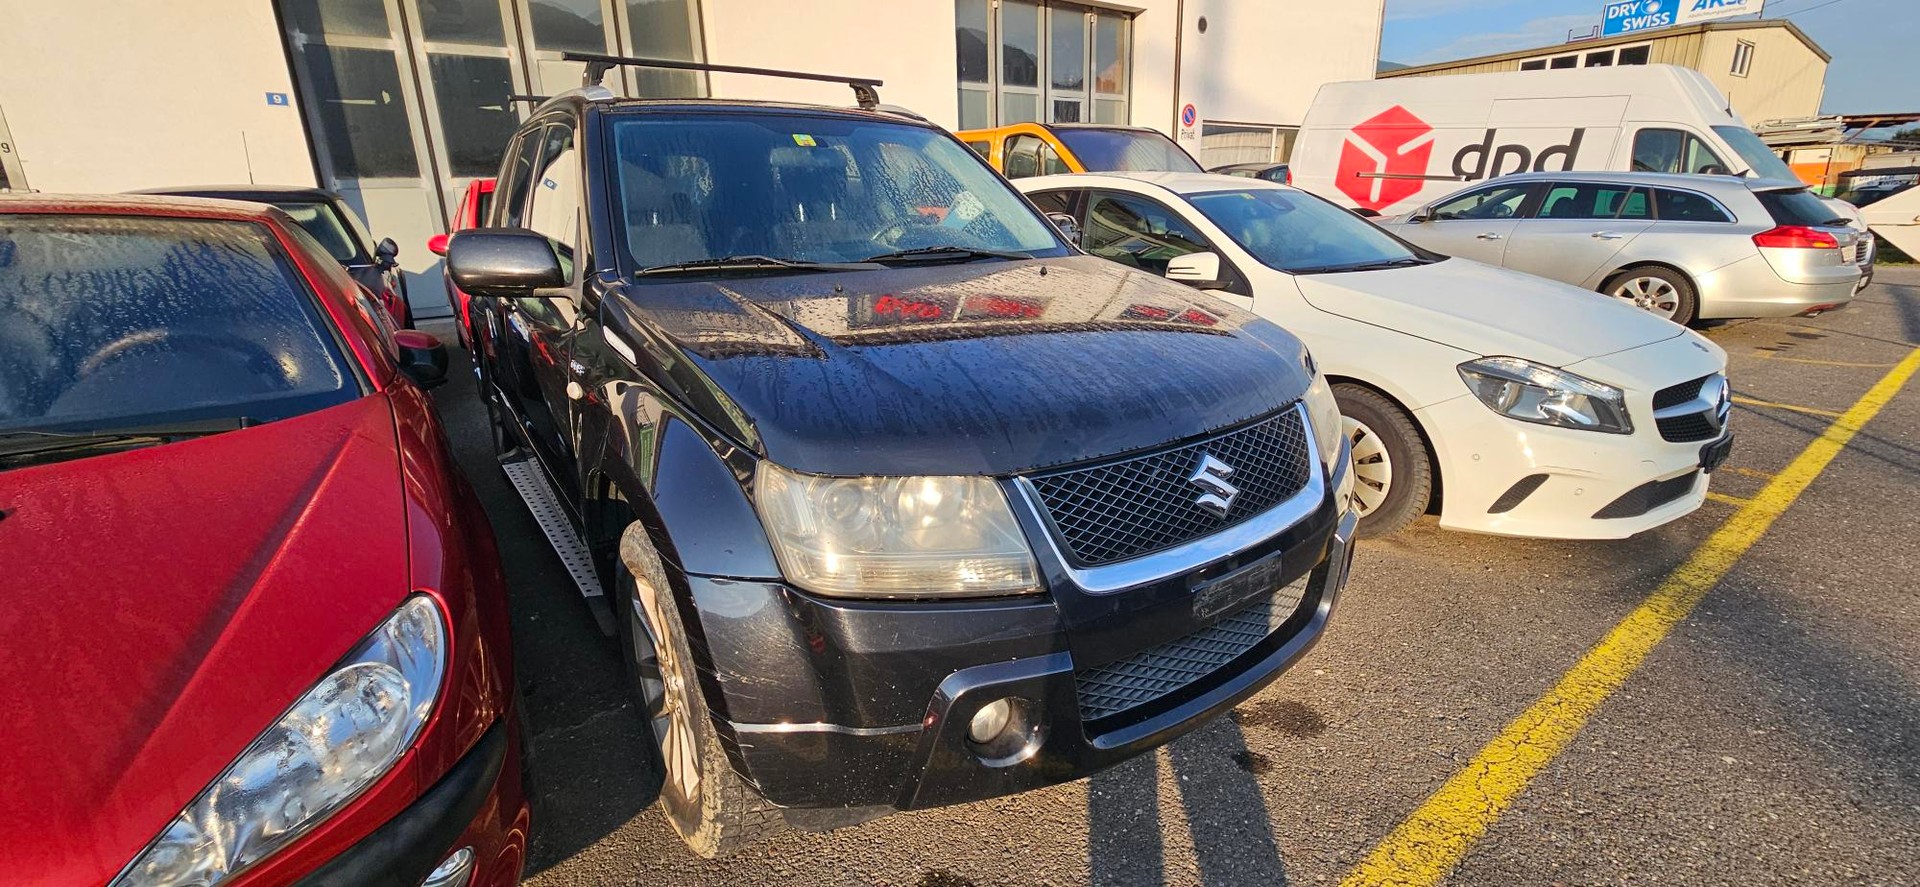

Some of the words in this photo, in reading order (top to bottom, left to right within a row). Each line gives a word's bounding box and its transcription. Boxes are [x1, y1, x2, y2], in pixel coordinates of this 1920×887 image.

[1608, 1, 1638, 19] DRY
[1622, 12, 1670, 31] SWISS
[273, 94, 282, 104] 9
[1, 142, 10, 153] 9
[1452, 128, 1586, 180] dpd
